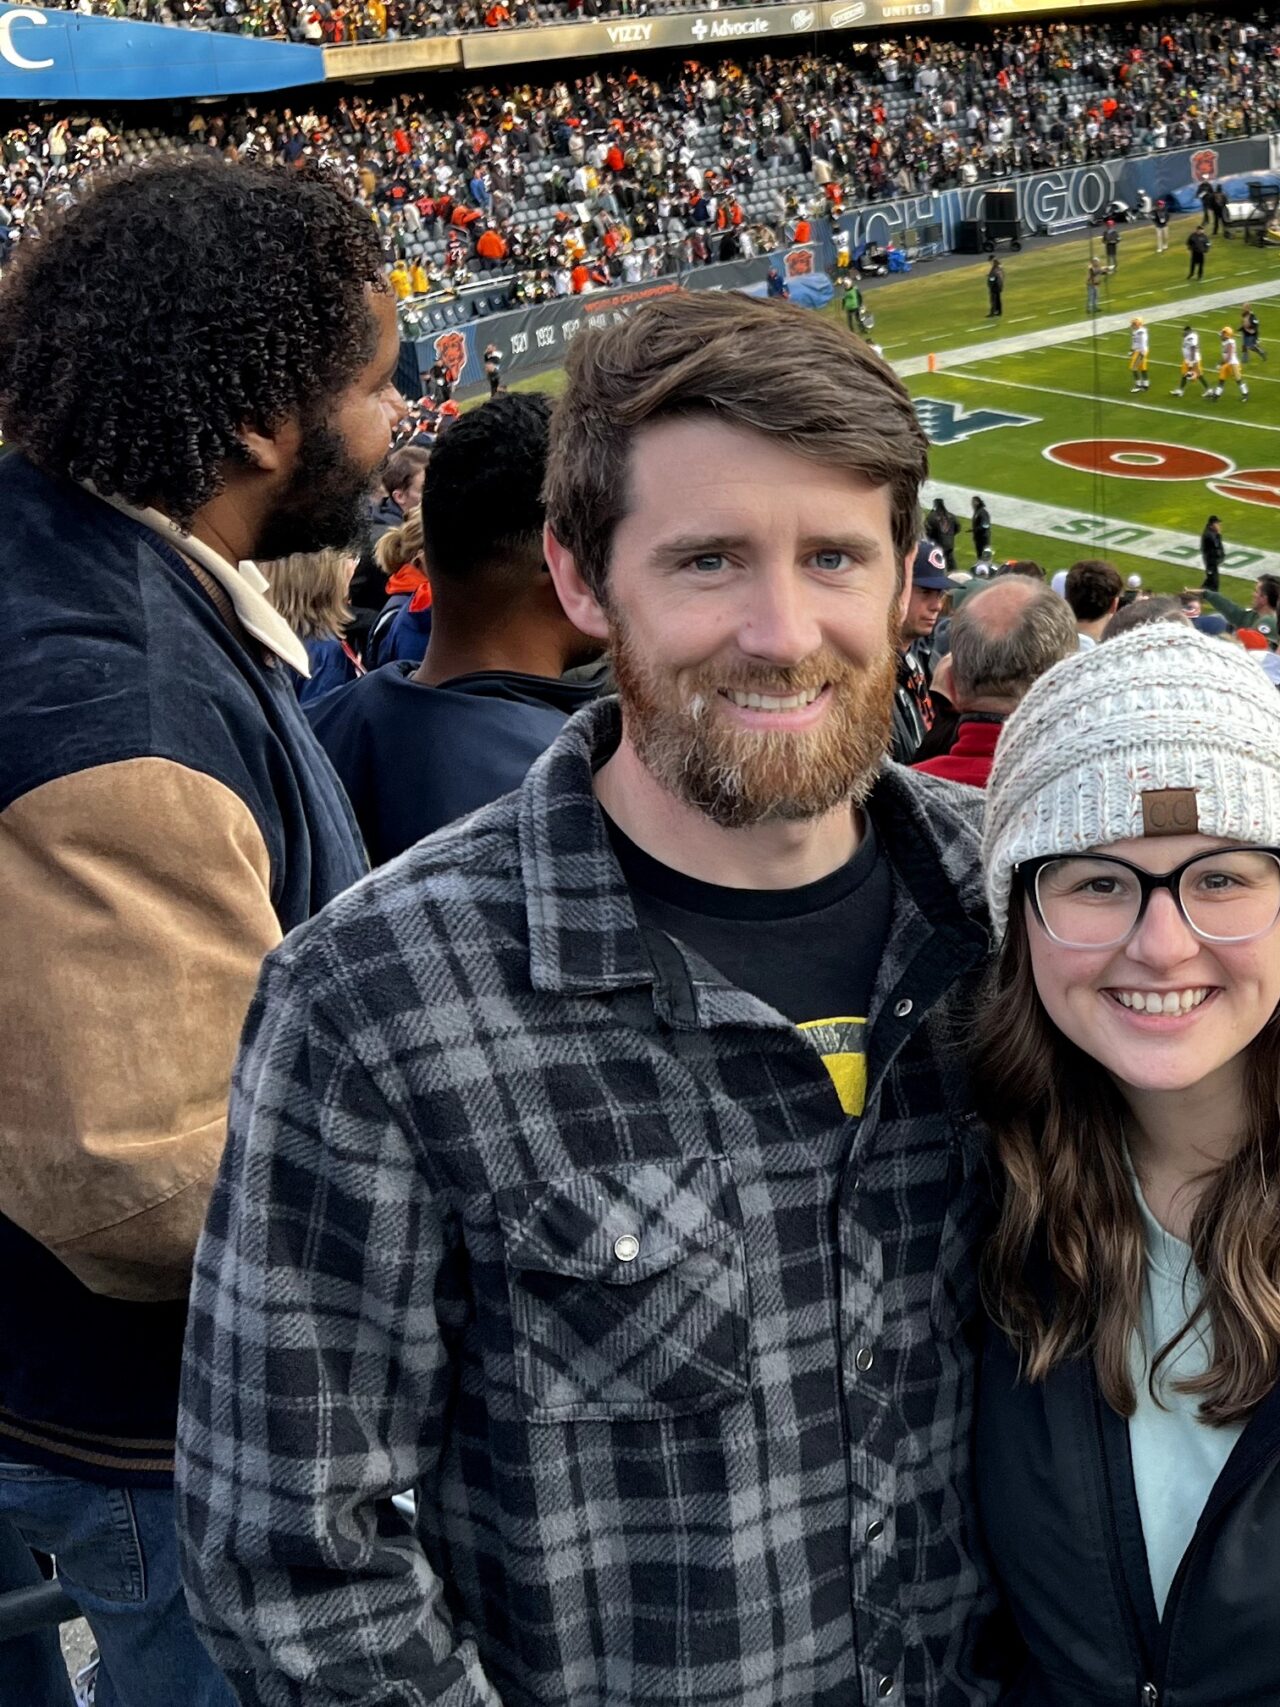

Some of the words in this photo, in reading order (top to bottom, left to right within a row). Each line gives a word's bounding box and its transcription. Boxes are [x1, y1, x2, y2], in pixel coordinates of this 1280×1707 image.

[882, 4, 931, 18] UNITED
[606, 23, 653, 43] VIZZY
[710, 17, 770, 38] Advocate
[535, 324, 557, 347] 1932
